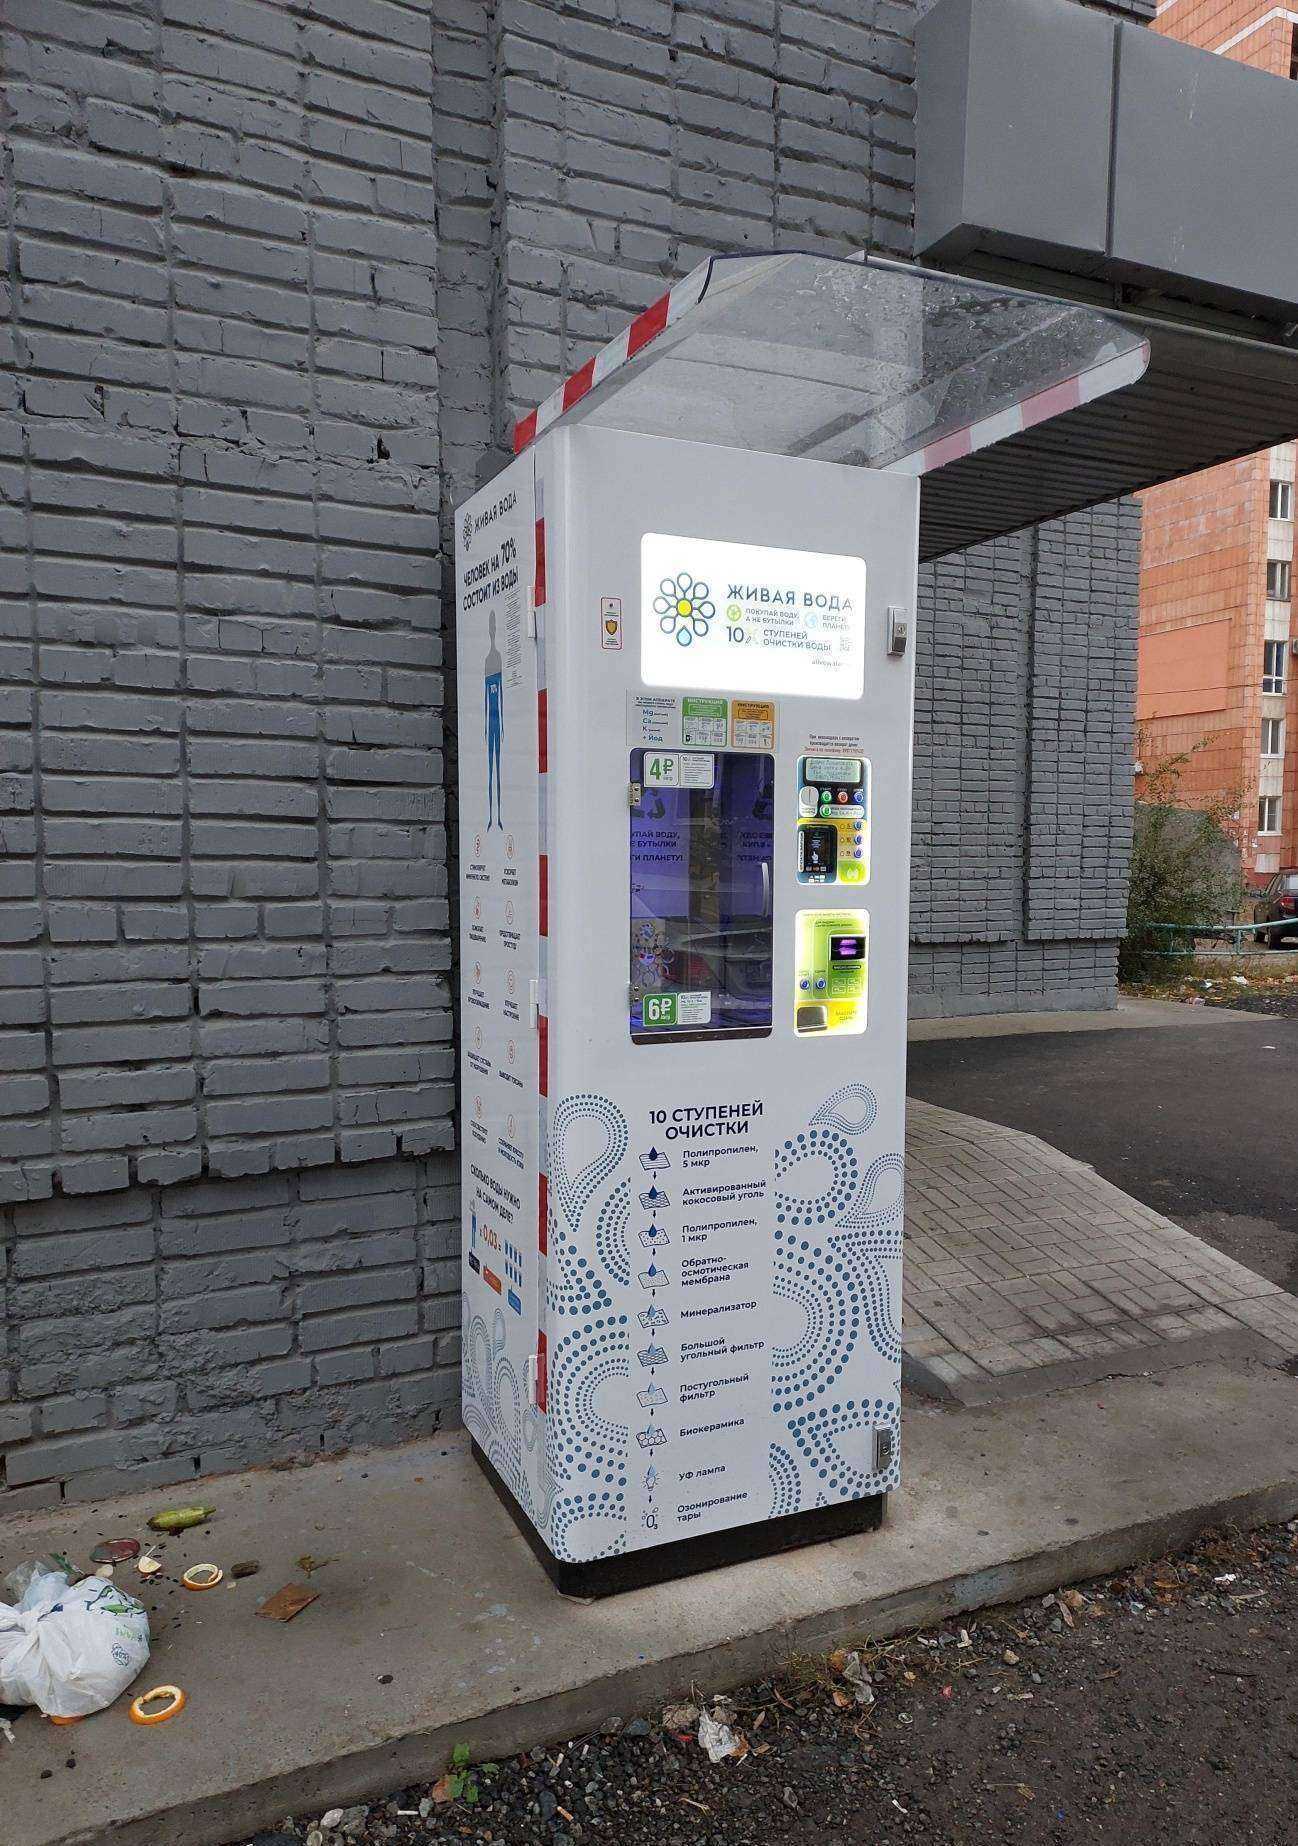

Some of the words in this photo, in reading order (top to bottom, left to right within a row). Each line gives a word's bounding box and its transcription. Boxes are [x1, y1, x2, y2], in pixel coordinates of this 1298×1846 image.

[474, 505, 498, 533] ЖИВАЯ
[499, 490, 517, 516] ВОДА
[463, 560, 490, 587] ЧЕЛОВЕК
[491, 554, 500, 573] НА
[501, 537, 517, 567] 70%
[463, 582, 491, 611] СОСТОИТ
[492, 577, 500, 596] ИЗ
[501, 566, 519, 591] ВОДЫ
[727, 584, 795, 605] ЖИВАЯ
[804, 592, 852, 611] ВОДА
[746, 608, 779, 618] ПОКУПАЙ
[779, 611, 799, 620] ВОДУ,
[762, 617, 794, 626] БУТЫЛКИ
[726, 626, 744, 643] 10
[763, 629, 808, 640] СТУПЕНЕЙ
[763, 639, 804, 649] ОЧИСТКИ
[805, 642, 831, 652] ВОДЫ
[642, 709, 654, 717] Mg
[655, 831, 680, 840] ВОДУ,
[637, 841, 677, 849] БУТЫЛКИ
[642, 854, 683, 862] ПЛАНЕТУ!
[649, 1110, 667, 1124] 10
[672, 1100, 763, 1122] СТУПЕНЕЙ
[665, 1120, 749, 1140] ОЧИСТКИ
[682, 1145, 759, 1159] Полипропилен,
[682, 1160, 688, 1168] 5
[691, 1159, 710, 1168] мкр
[470, 1163, 490, 1186] СКОЛЬКО
[503, 1188, 521, 1210] НУЖНО
[682, 1180, 766, 1197] Активированный
[682, 1193, 736, 1206] кокосовый
[738, 1191, 764, 1202] уголь
[682, 1218, 758, 1233] Полипропилен,
[688, 1233, 708, 1242] мкр
[681, 1256, 727, 1268] Обратно-
[681, 1262, 749, 1278] осмотическая
[681, 1274, 731, 1287] мембрана
[680, 1301, 757, 1319] Минерализатор
[680, 1337, 725, 1351] Большой
[680, 1346, 728, 1362] угольный
[730, 1341, 765, 1354] фильтр
[679, 1373, 749, 1393] Постугольный
[679, 1389, 716, 1403] фильтр
[679, 1417, 745, 1437] Биокерамика
[679, 1471, 694, 1482] УФ
[695, 1465, 726, 1478] лампа
[677, 1492, 748, 1513] Озонирование
[677, 1511, 701, 1522] тары
